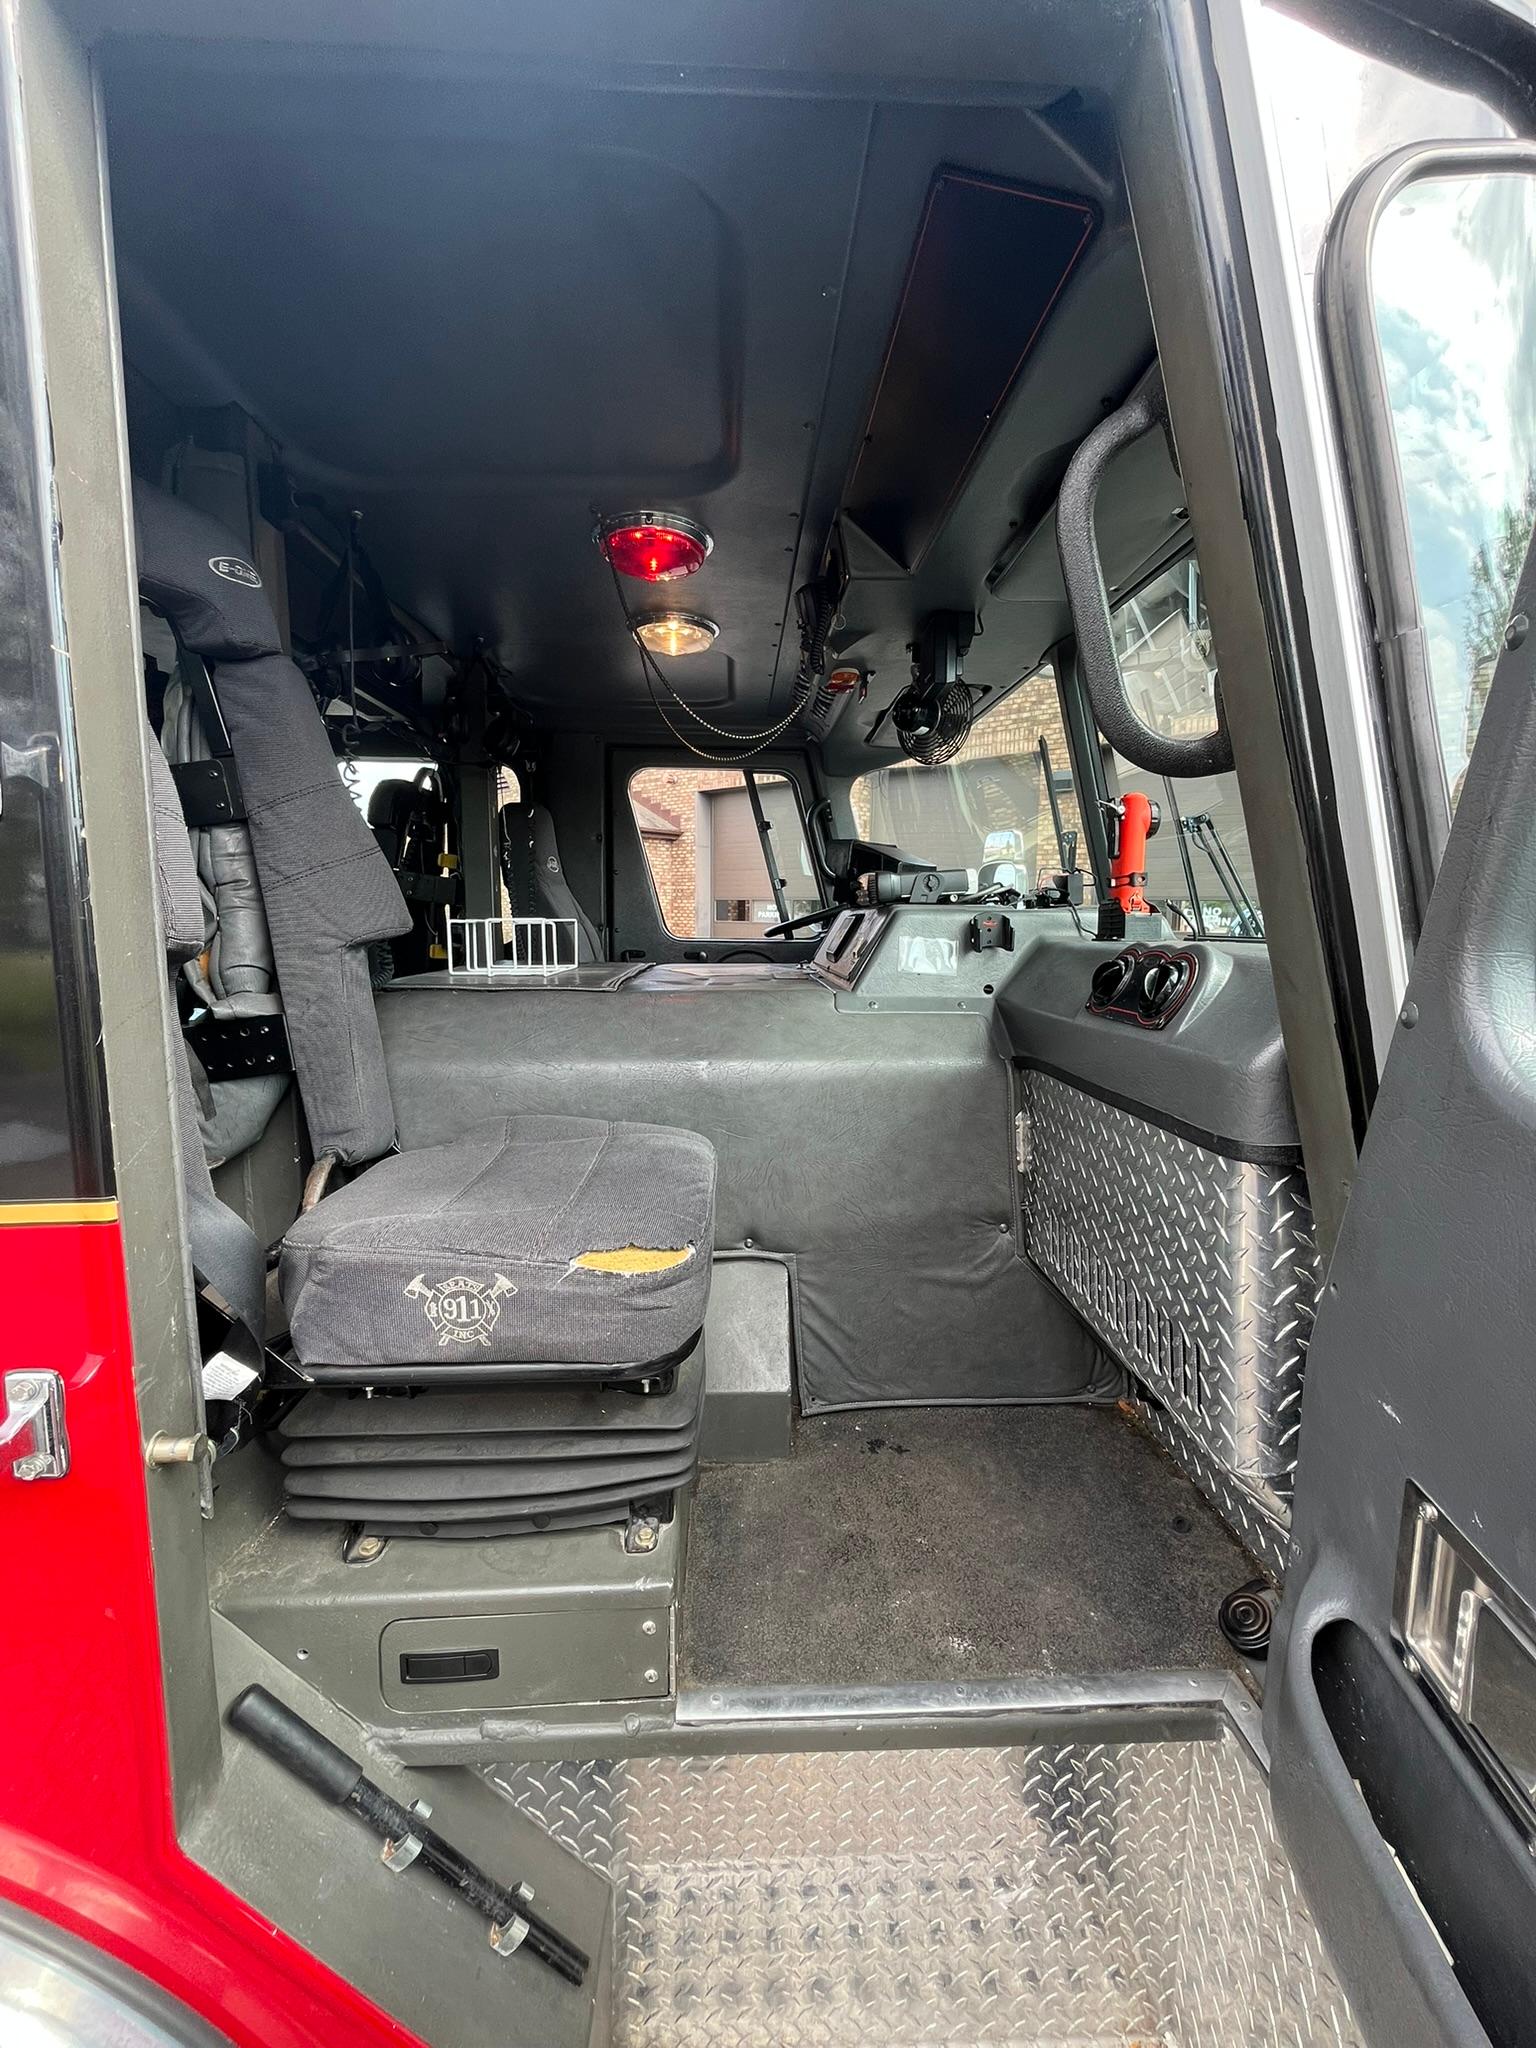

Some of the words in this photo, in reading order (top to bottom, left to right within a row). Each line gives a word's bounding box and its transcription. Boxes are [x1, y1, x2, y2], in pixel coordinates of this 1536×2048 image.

[1203, 906, 1222, 916] NO
[442, 1280, 479, 1292] SEATS
[443, 1296, 481, 1322] 911
[454, 1330, 474, 1339] INC
